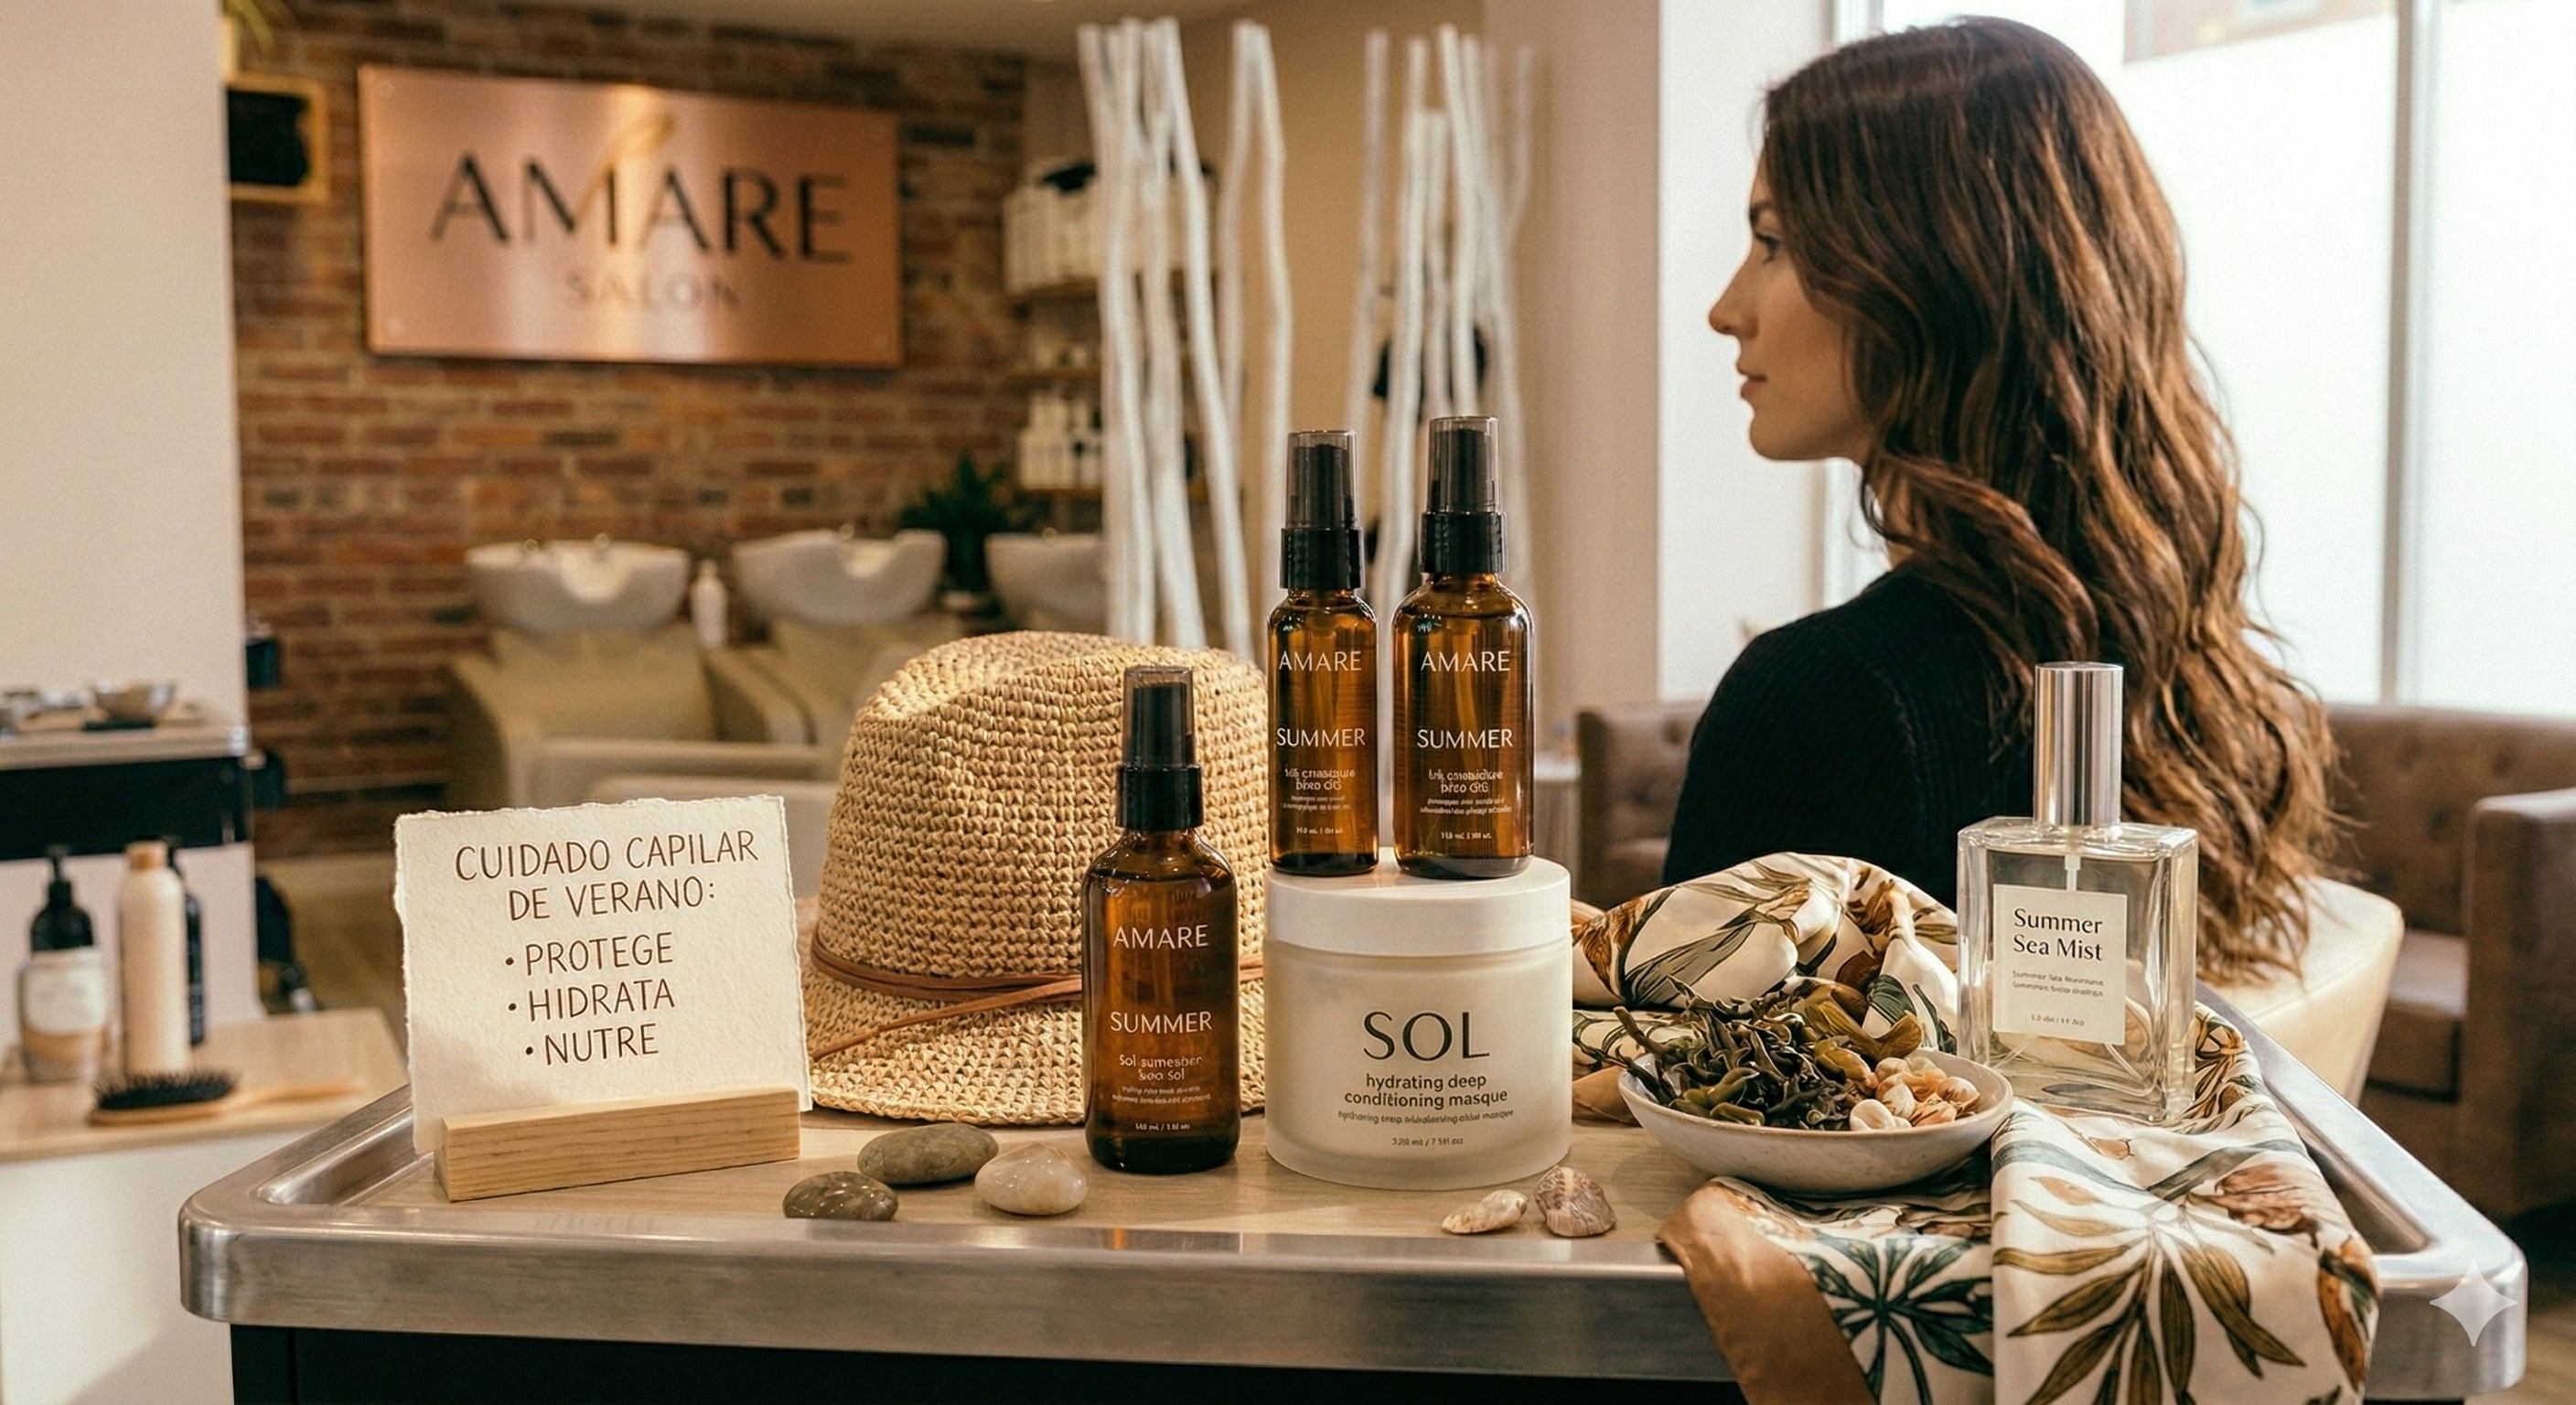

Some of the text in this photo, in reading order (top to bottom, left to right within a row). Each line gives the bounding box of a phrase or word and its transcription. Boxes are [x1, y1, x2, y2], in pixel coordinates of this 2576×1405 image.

[429, 150, 852, 263] AMARE
[564, 269, 741, 310] SALON
[1278, 649, 1362, 672] AMARE
[1421, 650, 1511, 672] AMARE
[1276, 727, 1367, 748] SUMMER
[1417, 728, 1514, 749] SUMMER
[456, 830, 759, 881] CUIDADO CAPILAR
[509, 875, 716, 921] DE VERANO:
[2013, 907, 2103, 934] Summer
[1112, 924, 1209, 949] AMARE
[2012, 933, 2103, 961] Sea Mist
[525, 931, 674, 976] PROTEGE
[528, 978, 676, 1022] HIDRATA
[1110, 1011, 1213, 1035] SUMMER
[1363, 1011, 1490, 1062] SOL
[544, 1023, 660, 1066] NUTRE
[1366, 1073, 1487, 1092] hydrating deep
[1344, 1090, 1508, 1110] conditioning masque
